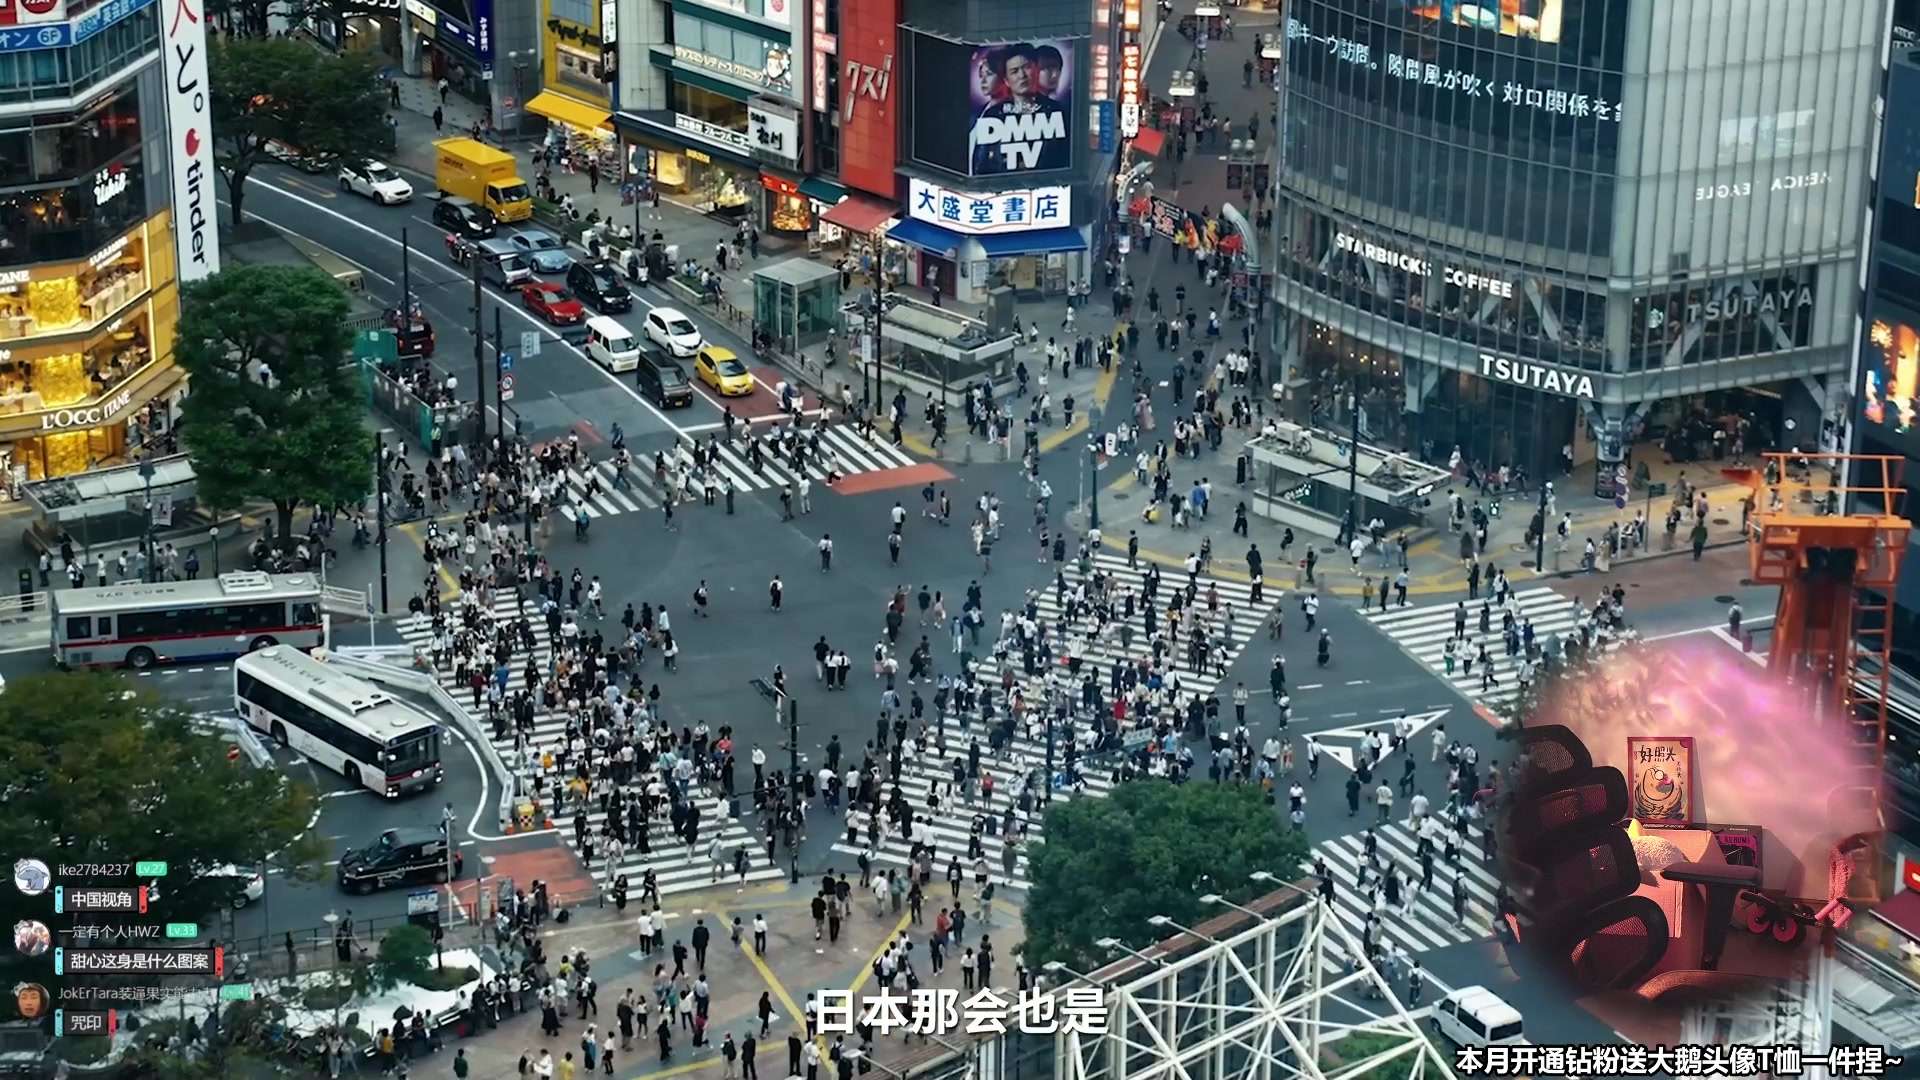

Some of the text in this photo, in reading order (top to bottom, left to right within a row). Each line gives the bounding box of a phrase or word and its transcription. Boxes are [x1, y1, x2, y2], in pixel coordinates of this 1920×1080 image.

[40, 30, 59, 43] 6F
[976, 111, 1066, 145] DMM
[1000, 141, 1043, 170] TV
[187, 159, 206, 264] tinder
[917, 188, 1059, 224] 大盛堂書店
[1336, 232, 1513, 299] STARBUCKS COFFEE
[1687, 286, 1813, 323] TSUTAYA
[1479, 354, 1594, 399] TSUTAYA
